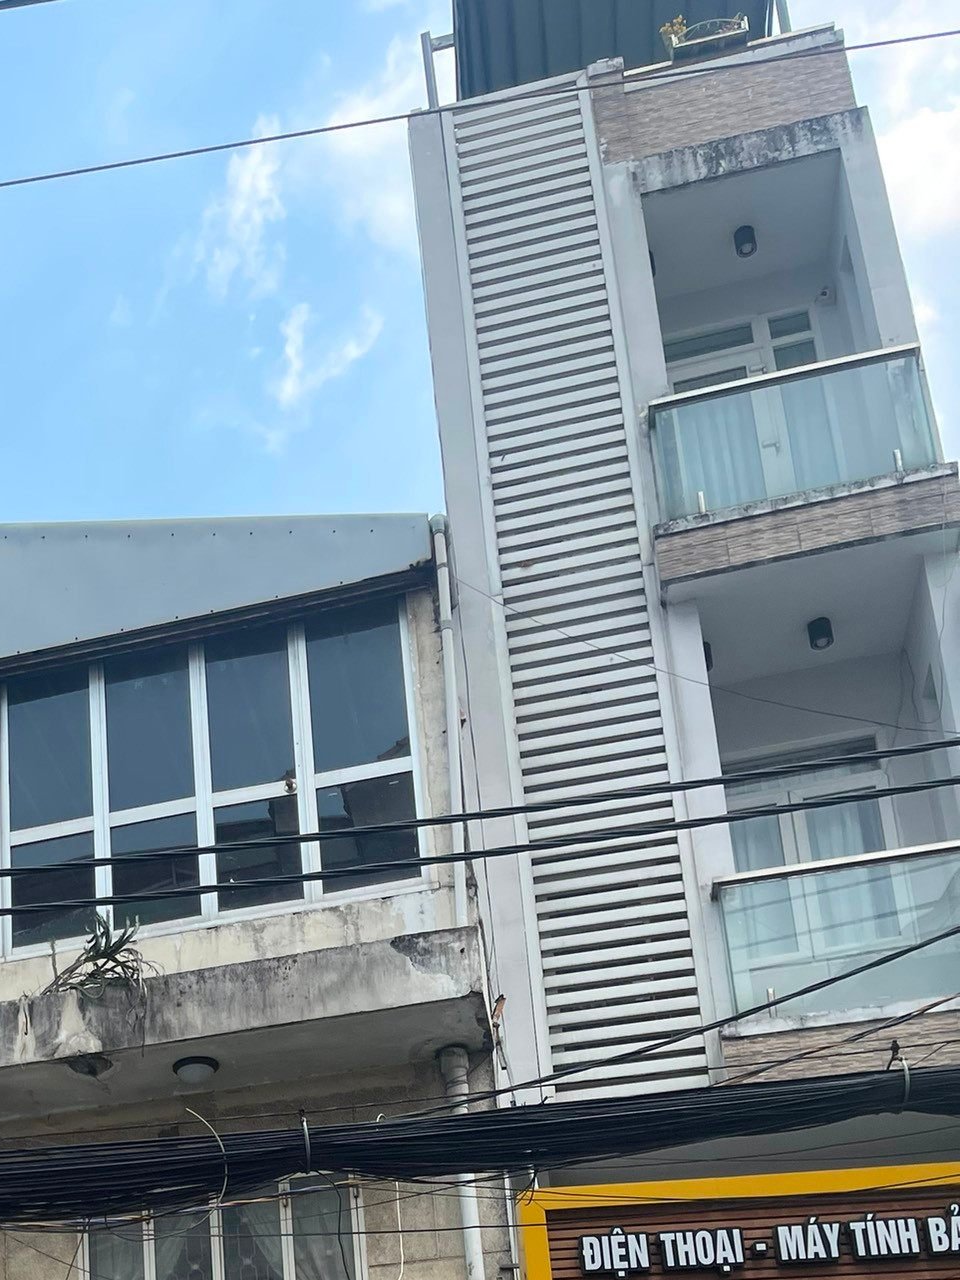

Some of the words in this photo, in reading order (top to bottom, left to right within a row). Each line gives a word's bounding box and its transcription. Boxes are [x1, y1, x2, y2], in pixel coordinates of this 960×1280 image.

[582, 1228, 650, 1278] ĐIỆN
[660, 1229, 744, 1271] THOẠI
[778, 1217, 840, 1261] MÁY
[849, 1213, 920, 1256] TÍNH
